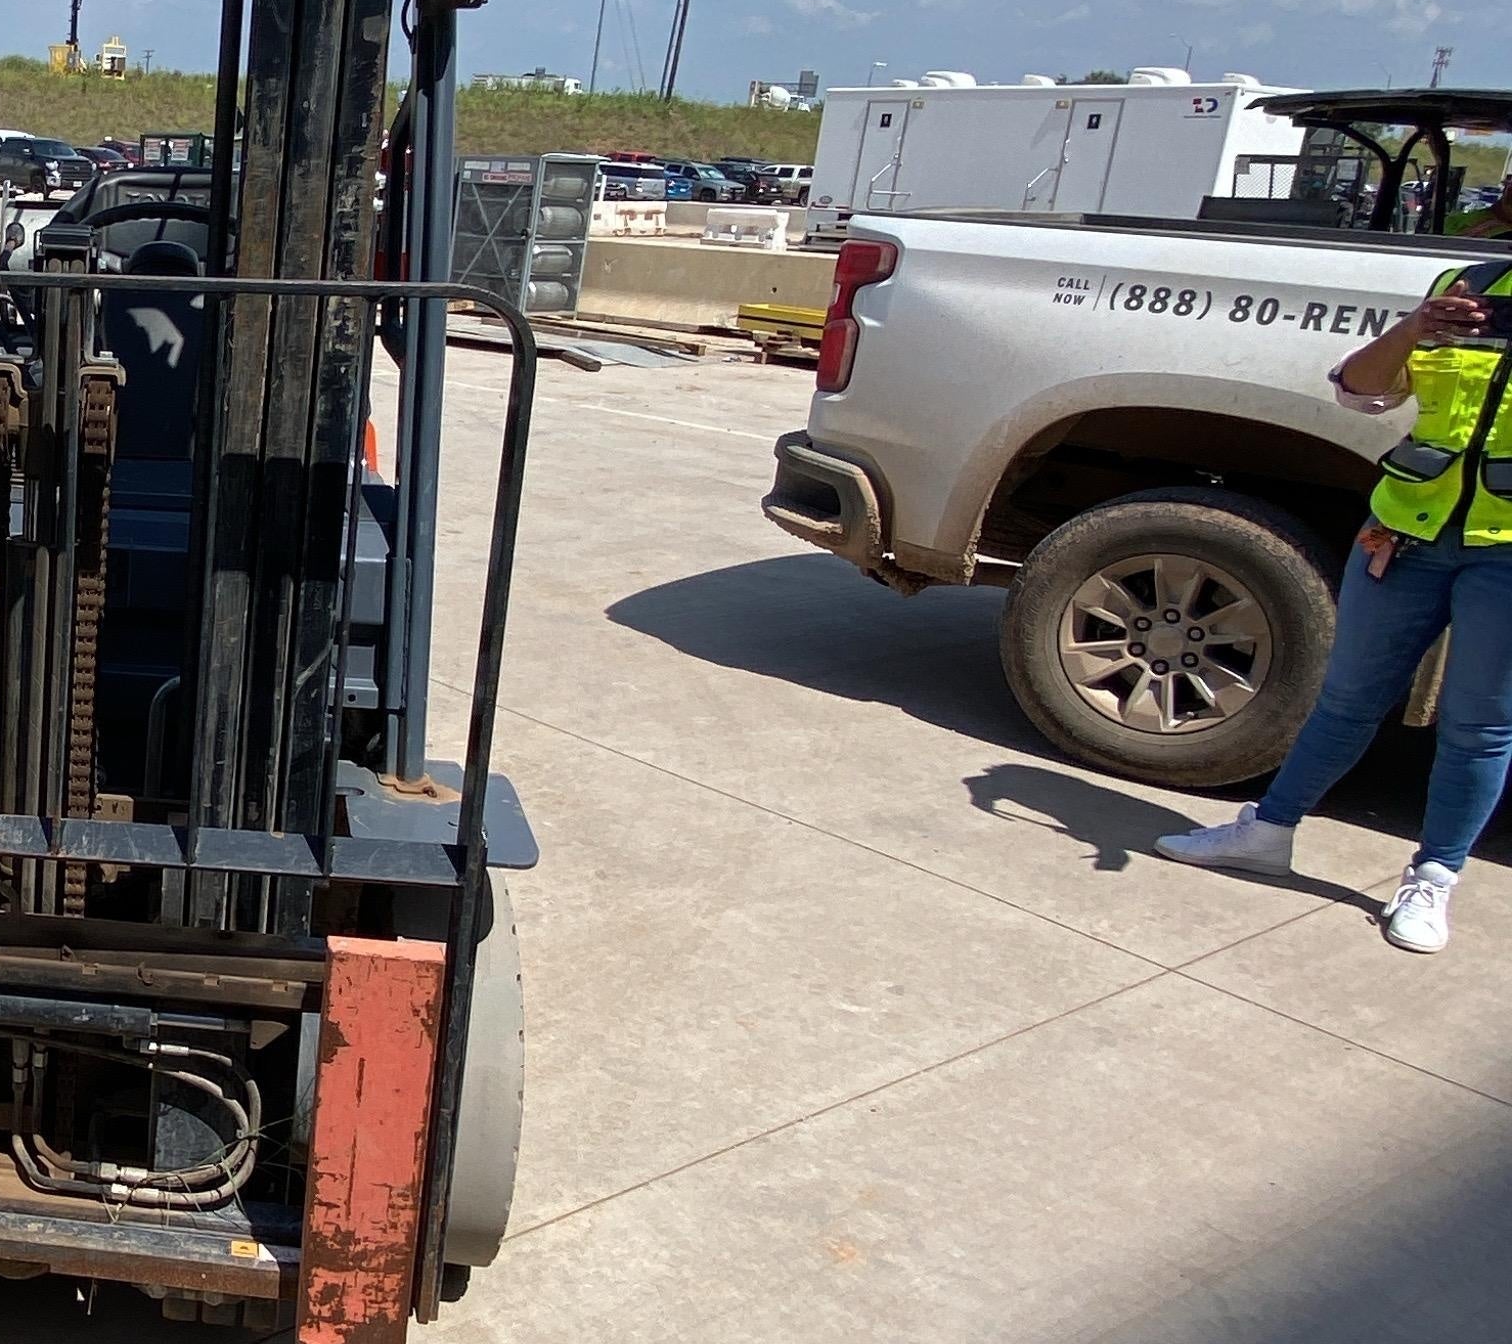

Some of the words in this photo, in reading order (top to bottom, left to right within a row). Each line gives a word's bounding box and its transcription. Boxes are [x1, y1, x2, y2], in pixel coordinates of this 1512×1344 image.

[1057, 277, 1090, 290] CALL
[1052, 293, 1086, 306] NOW
[1109, 282, 1212, 320] (888)
